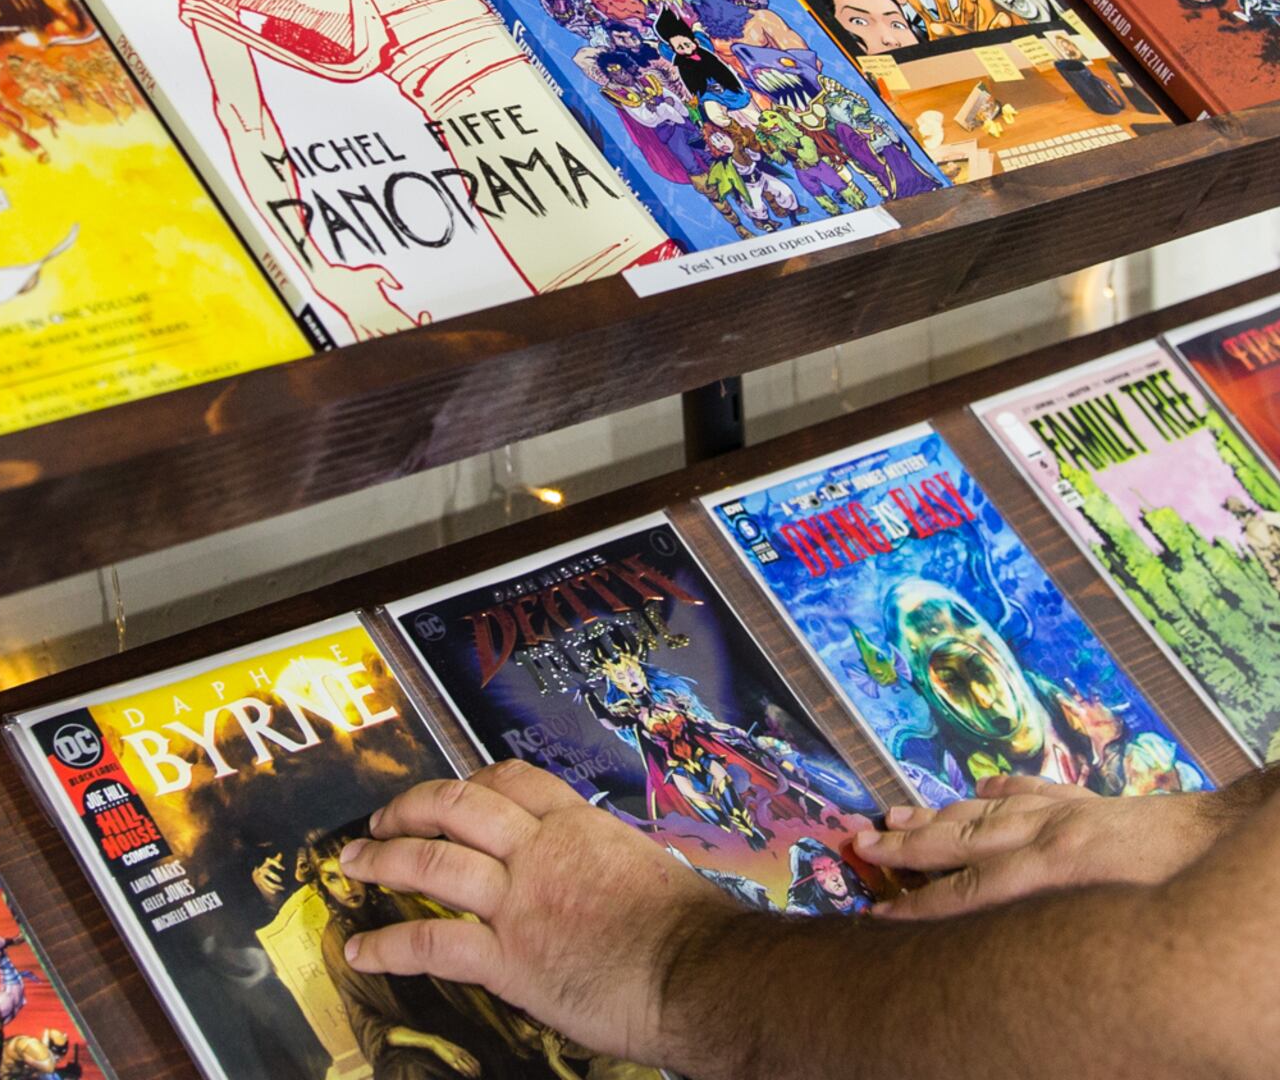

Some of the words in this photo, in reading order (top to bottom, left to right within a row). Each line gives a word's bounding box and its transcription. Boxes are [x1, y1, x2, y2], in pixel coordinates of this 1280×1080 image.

[1133, 39, 1175, 88] AMEZIANE
[262, 131, 407, 184] MICHEL
[424, 104, 539, 157] FIFFE
[266, 140, 623, 272] PANORAMA
[678, 258, 713, 277] Yes!
[714, 252, 748, 267] You
[750, 244, 778, 259] can
[779, 233, 817, 255] open
[816, 222, 856, 245] bags!
[83, 292, 150, 314] VOLUME
[1028, 392, 1150, 474] FAMILY
[1117, 369, 1208, 443] TREE
[869, 502, 910, 541] IS
[887, 471, 978, 541] EASY
[779, 499, 894, 579] DYING
[417, 614, 445, 639] DC
[462, 552, 705, 690] DEATH
[57, 729, 97, 762] DC
[121, 662, 399, 798] BYRNE
[68, 771, 97, 788] BLACK
[96, 763, 120, 778] LABEL
[86, 790, 108, 810] JOE
[103, 782, 129, 801] HILL
[95, 803, 145, 838] HILL
[100, 818, 162, 861] HOUSE
[121, 843, 161, 867] COMICS
[150, 859, 187, 884] MARKS
[163, 878, 196, 904] JONES
[183, 890, 224, 918] MADSEN
